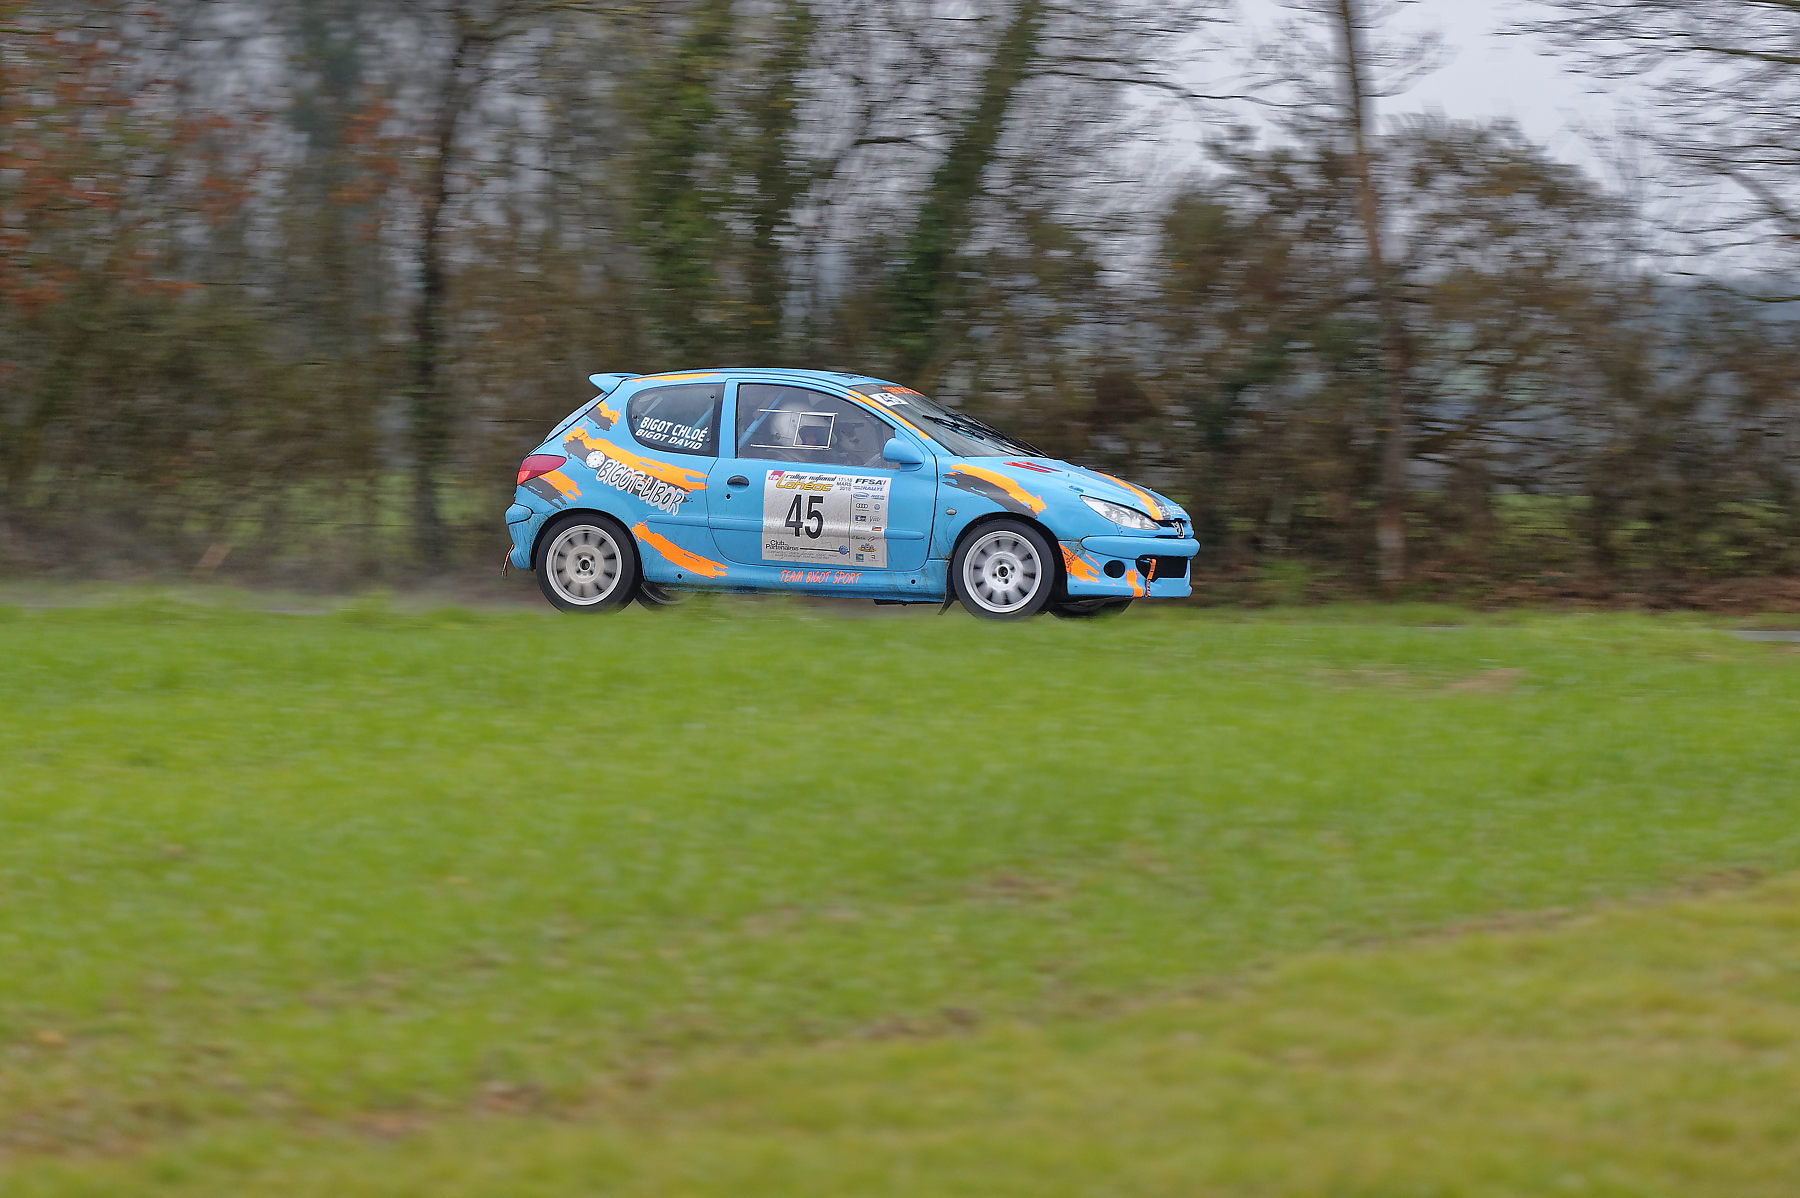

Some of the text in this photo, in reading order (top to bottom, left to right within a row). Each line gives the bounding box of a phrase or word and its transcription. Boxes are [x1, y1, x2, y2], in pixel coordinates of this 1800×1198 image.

[635, 428, 703, 450] BIGOT DAVID
[640, 416, 708, 441] BIGOT CHLOÉ
[596, 459, 684, 515] BIGOT-LIBOR
[784, 494, 824, 539] 45
[765, 543, 799, 551] Partenaires
[780, 569, 862, 584] TEAM BIGOT SPORT
